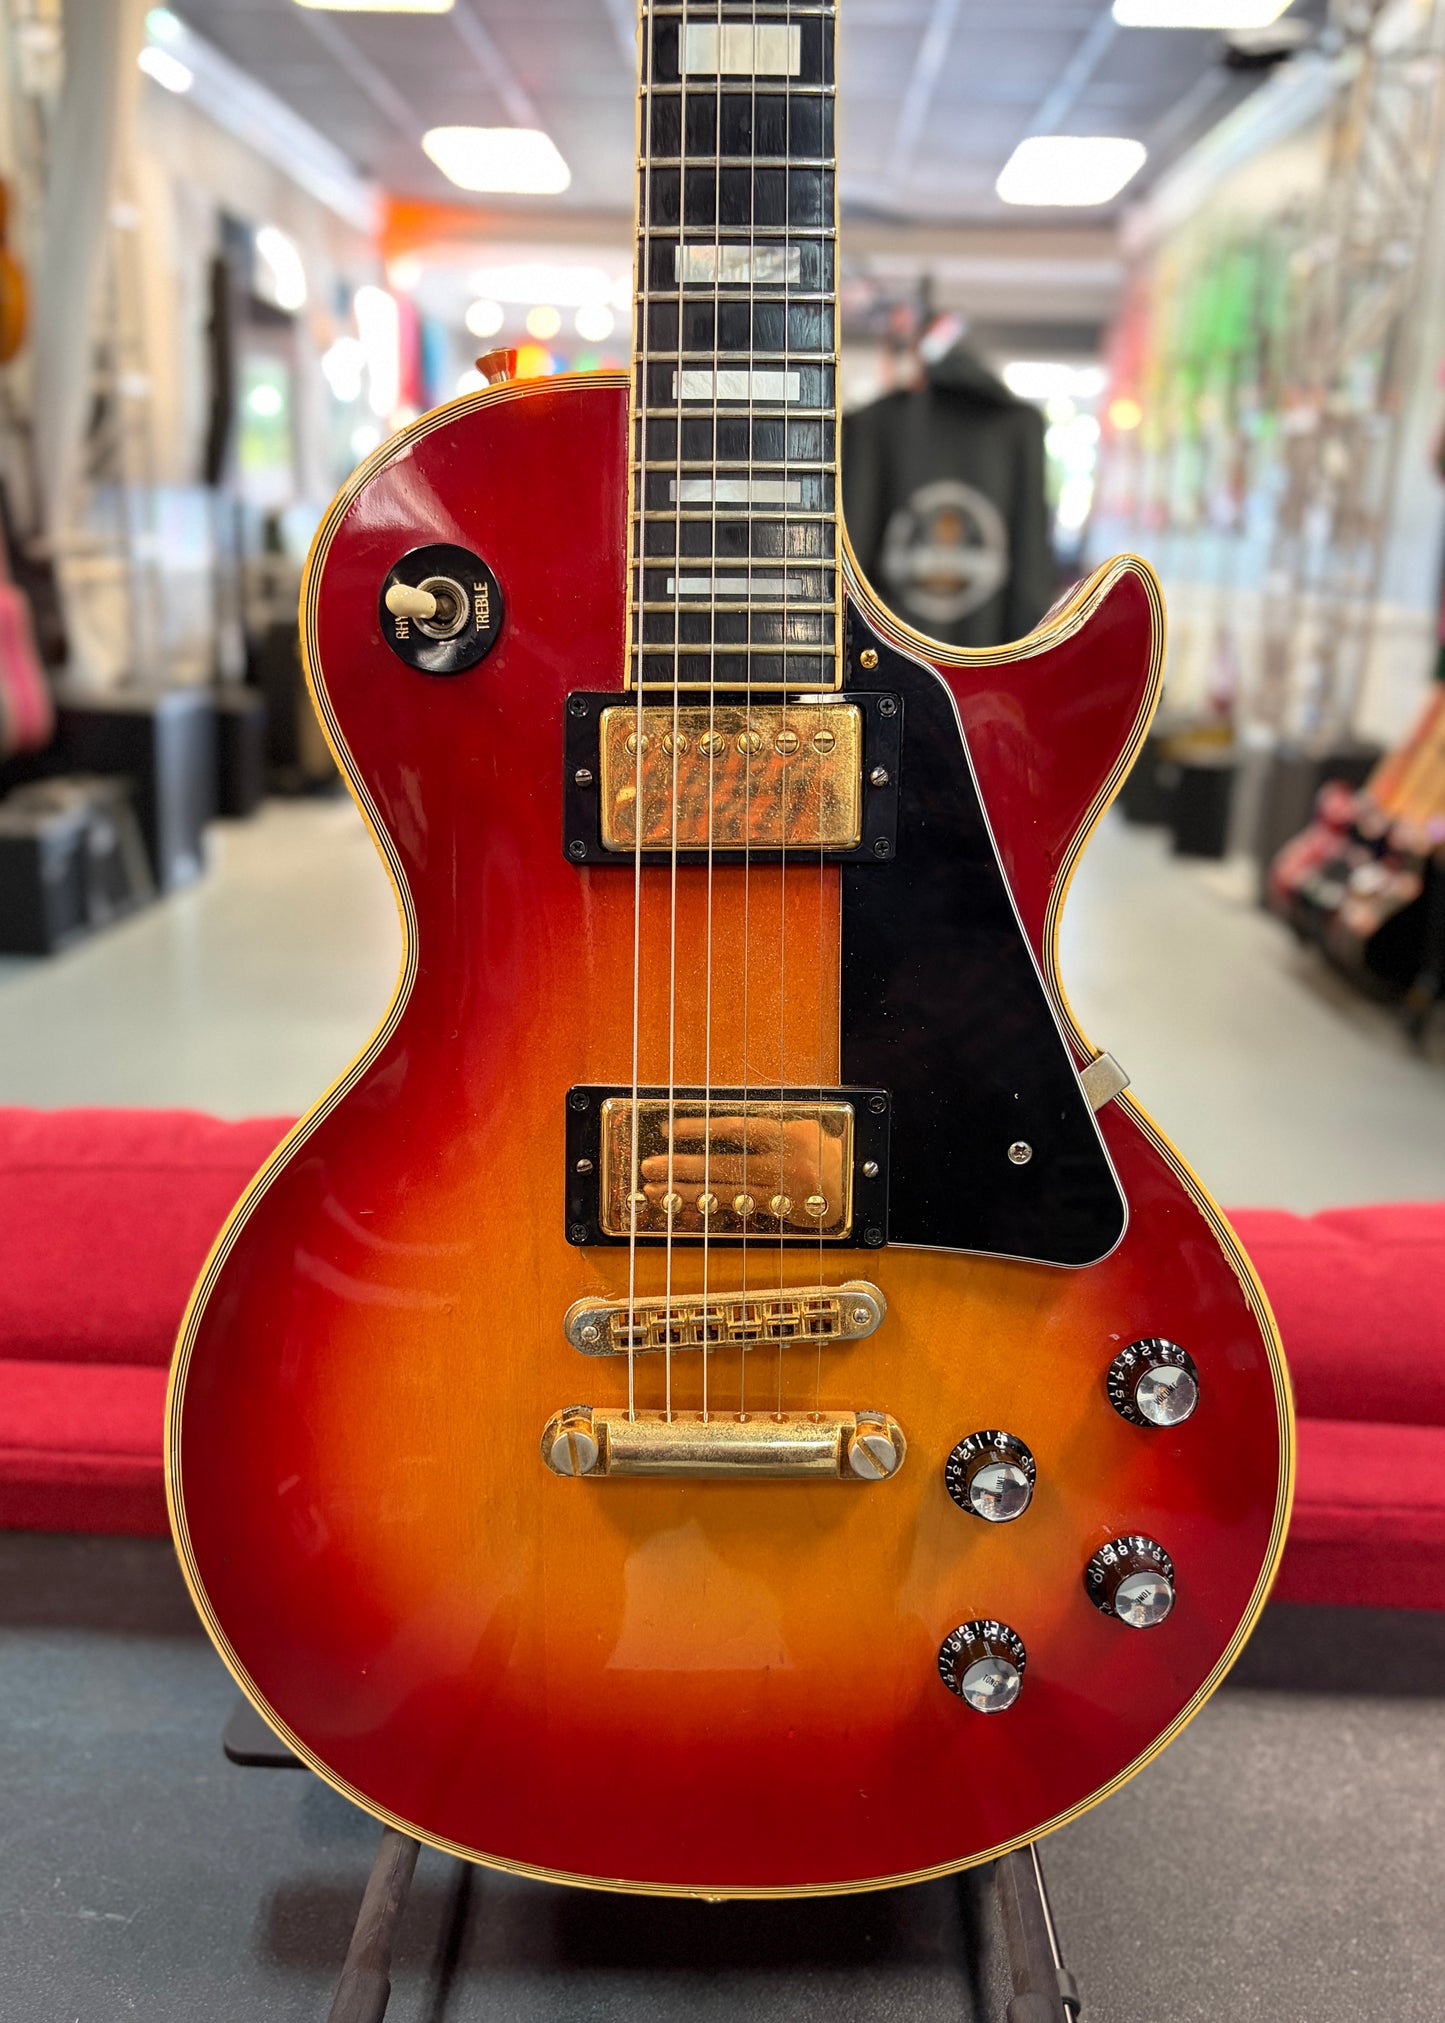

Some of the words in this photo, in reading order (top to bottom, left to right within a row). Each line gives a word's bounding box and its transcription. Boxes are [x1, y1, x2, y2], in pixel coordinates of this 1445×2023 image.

[473, 582, 490, 632] TREBLE
[1140, 1346, 1151, 1356] 2
[1115, 1371, 1124, 1381] 4
[1115, 1390, 1125, 1398] 5
[960, 1448, 971, 1460] 2
[1118, 1545, 1128, 1556] 8
[983, 1627, 992, 1638] 4
